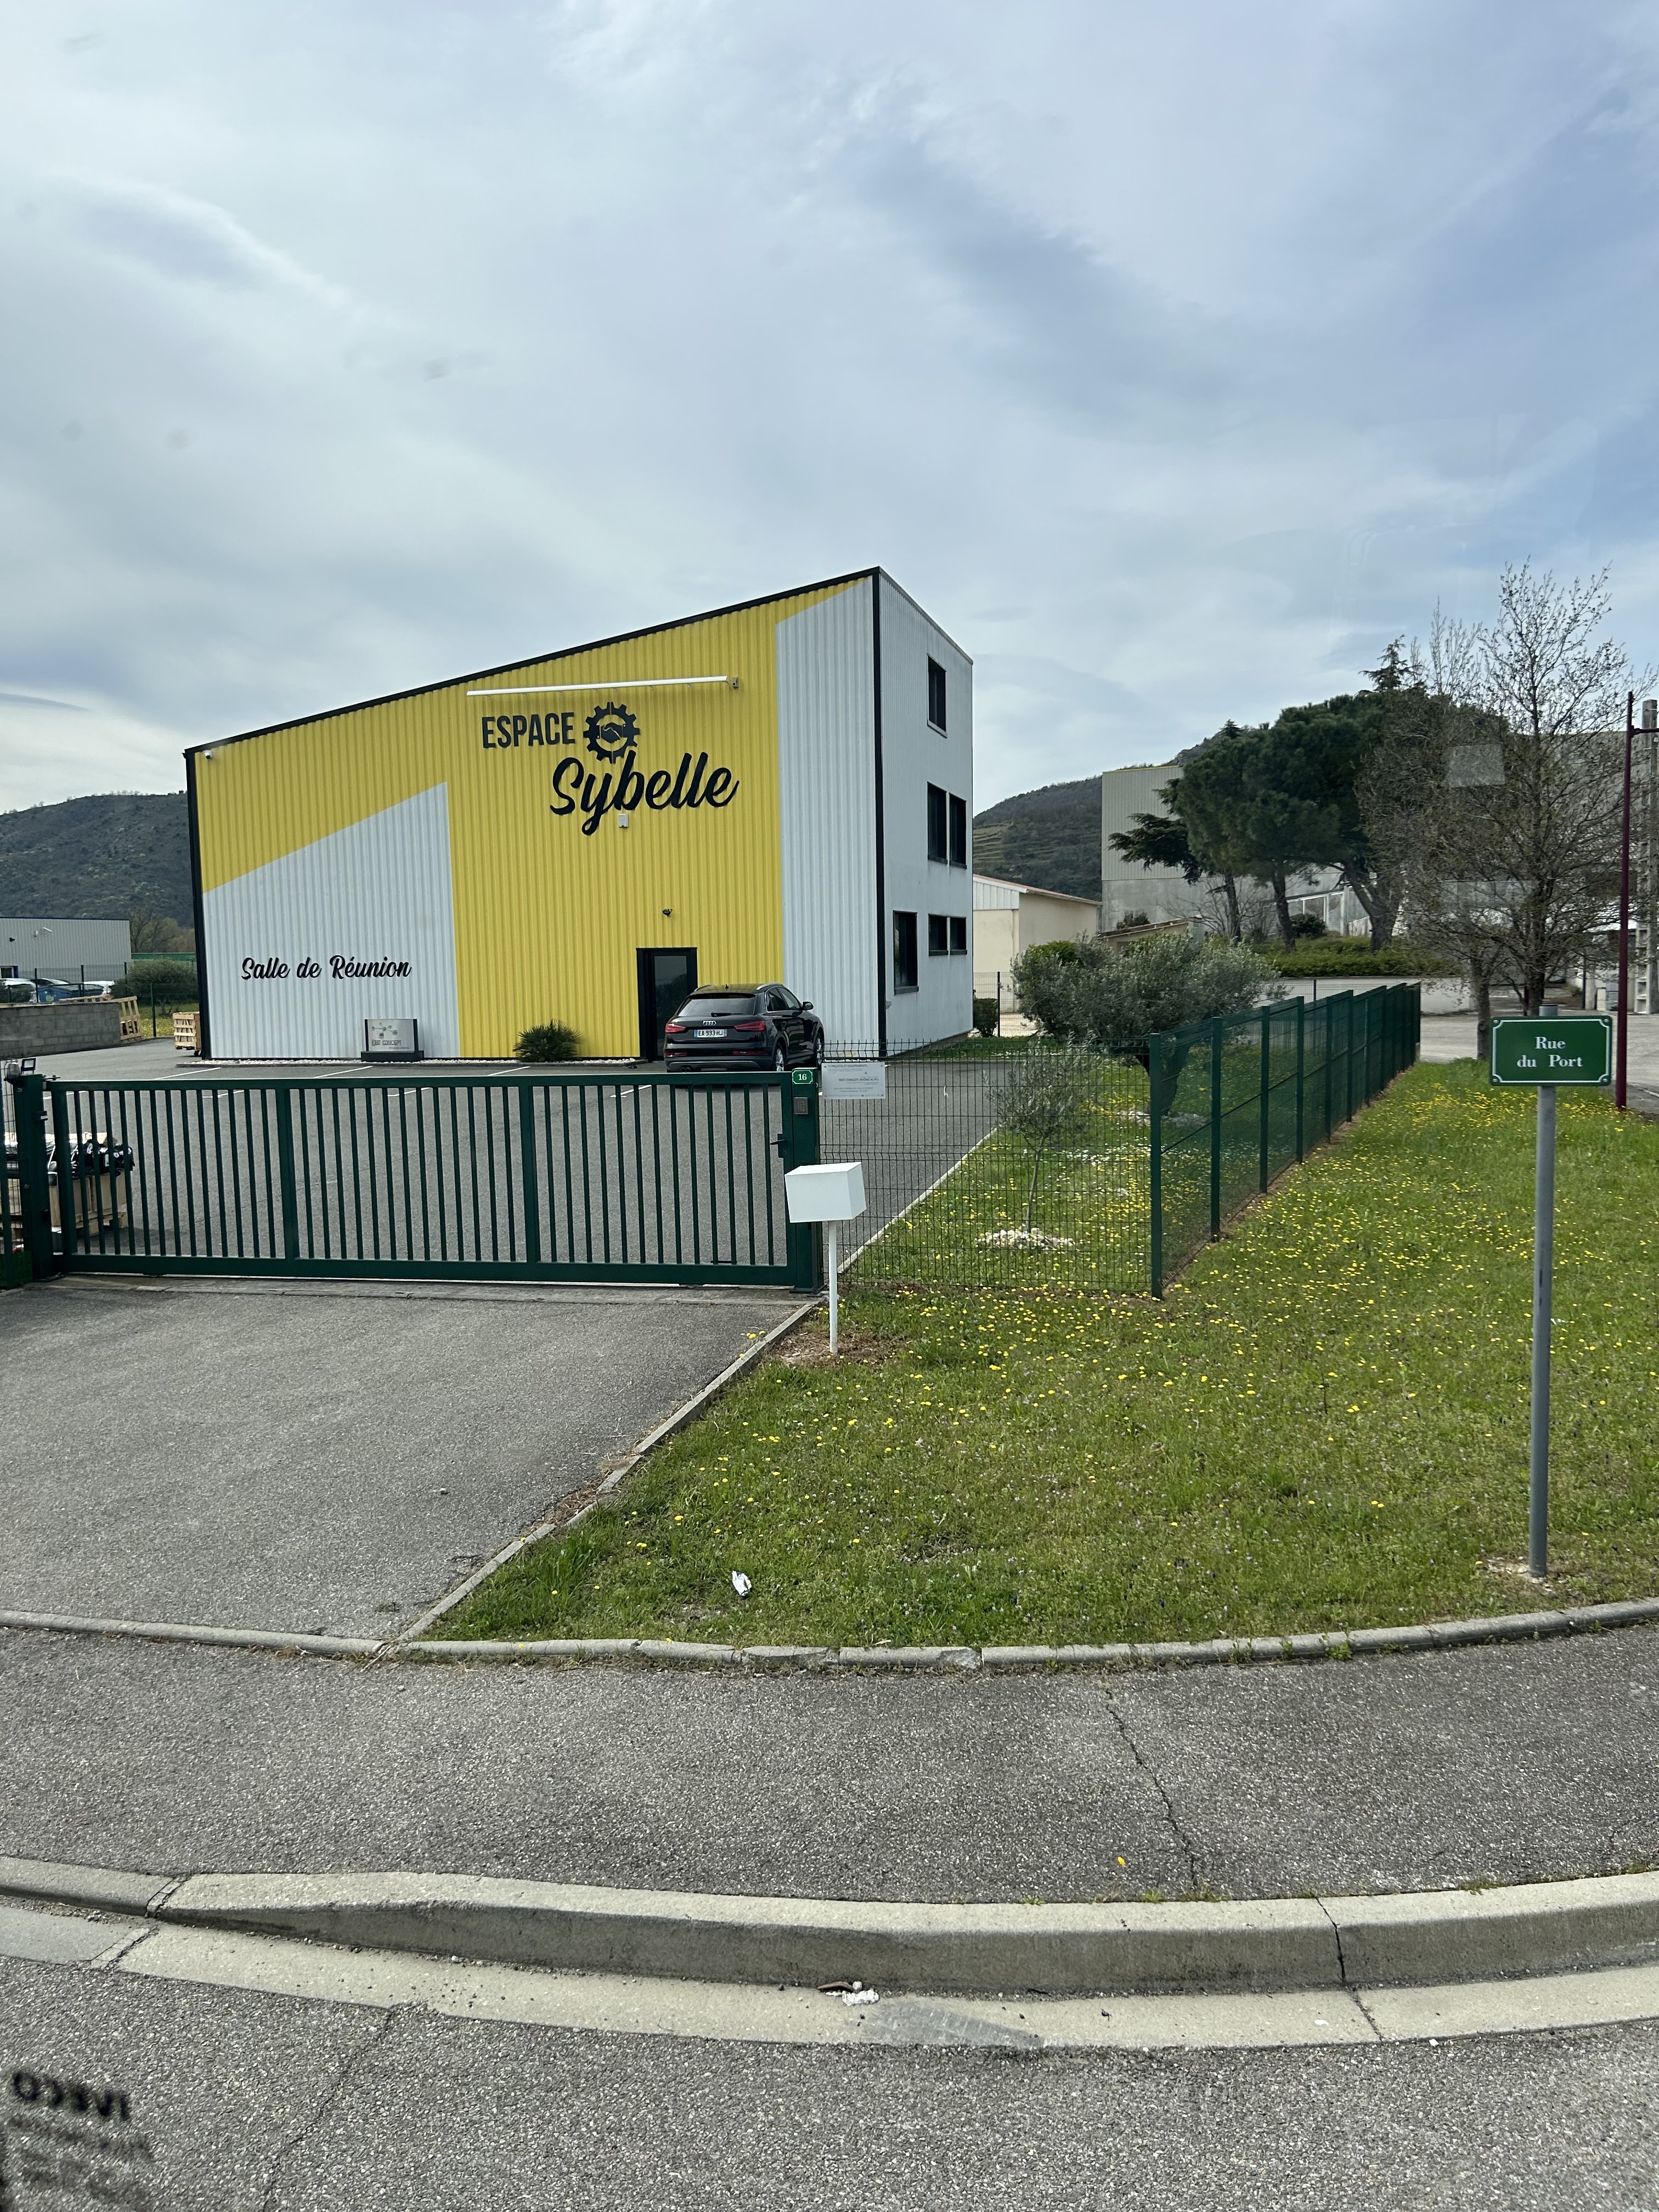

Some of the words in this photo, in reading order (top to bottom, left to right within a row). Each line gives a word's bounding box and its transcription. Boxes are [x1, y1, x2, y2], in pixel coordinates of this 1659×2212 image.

[482, 712, 575, 748] ESPACE
[550, 750, 740, 836] Sybelle
[241, 957, 290, 980] Salle
[296, 956, 322, 978] de
[329, 955, 412, 979] Réunion
[1535, 1036, 1566, 1049] Rue
[1517, 1055, 1537, 1068] du
[1549, 1054, 1583, 1067] Port
